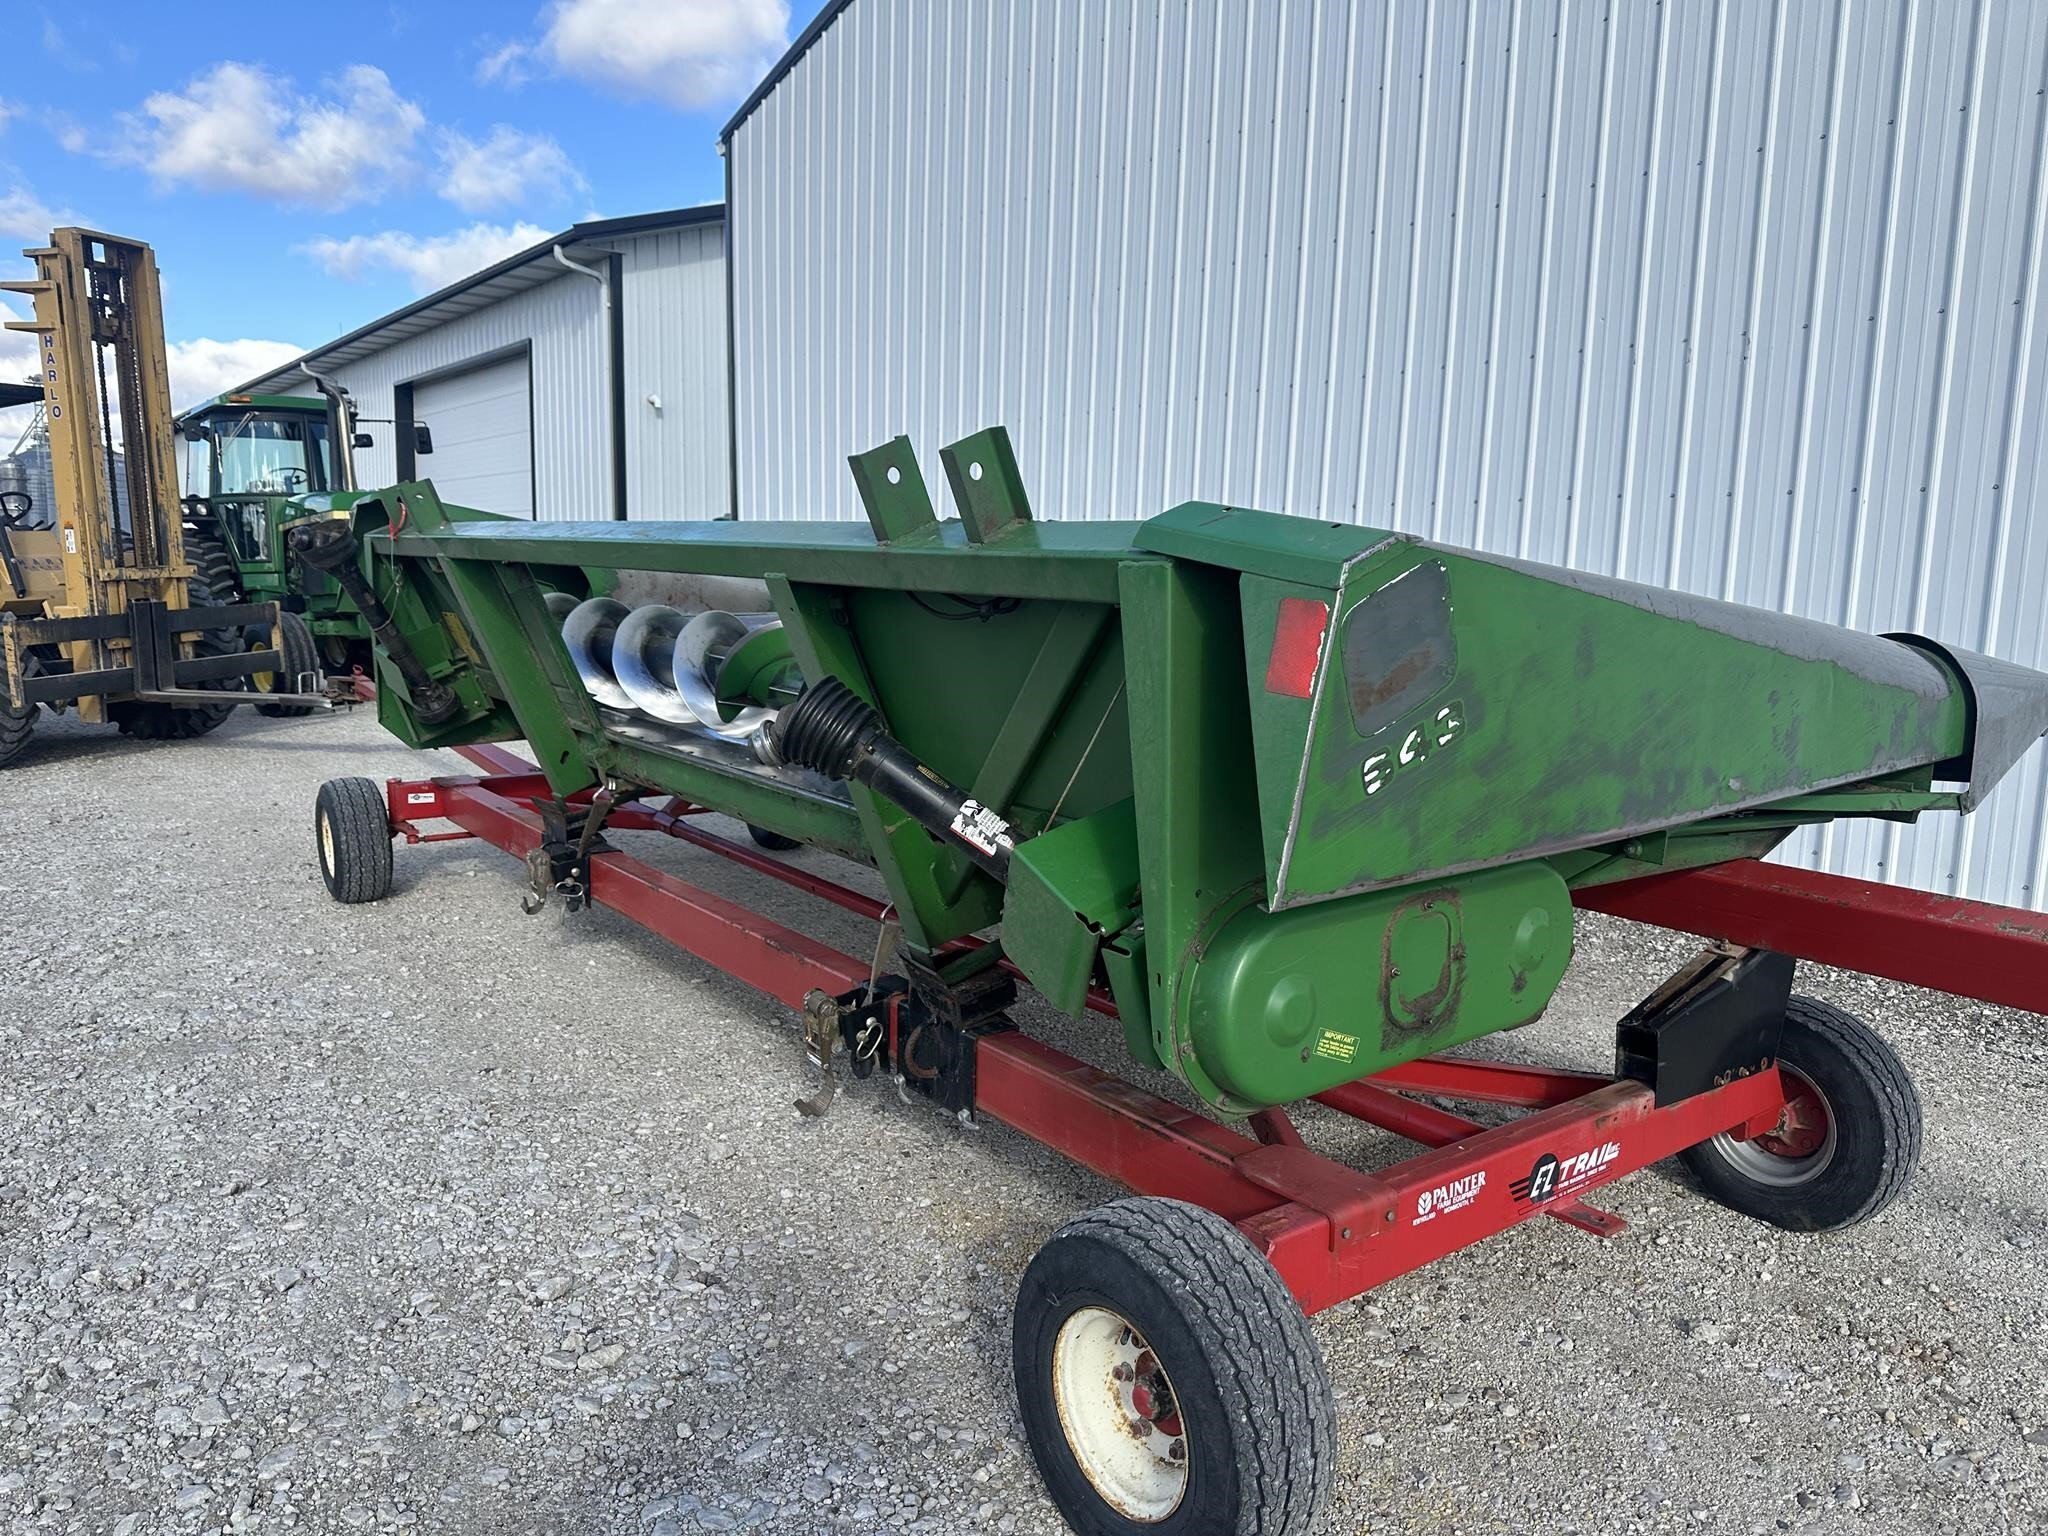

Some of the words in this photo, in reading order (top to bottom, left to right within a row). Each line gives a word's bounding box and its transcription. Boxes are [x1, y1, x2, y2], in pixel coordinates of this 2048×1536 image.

[44, 335, 62, 418] HARLO
[1324, 1031, 1355, 1044] IMPORTANT
[1559, 1142, 1620, 1182] TRAIL
[1432, 1170, 1486, 1206] PAINTER
